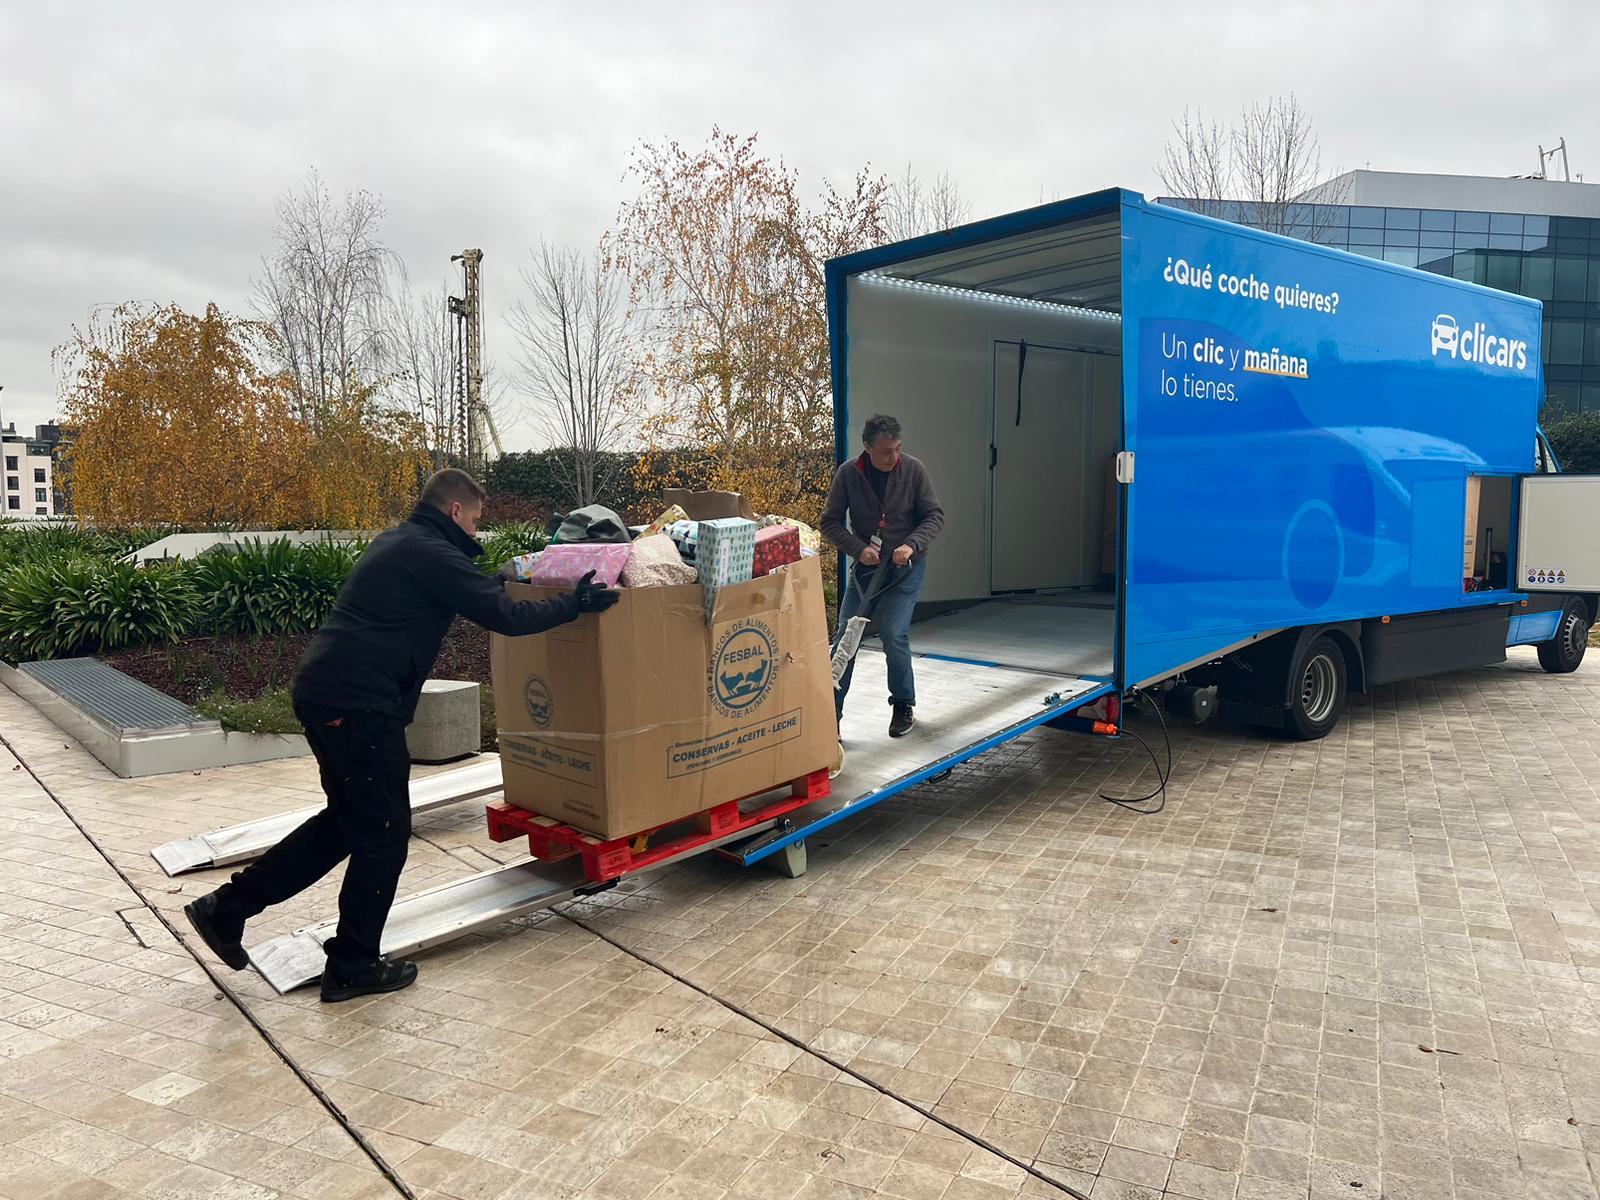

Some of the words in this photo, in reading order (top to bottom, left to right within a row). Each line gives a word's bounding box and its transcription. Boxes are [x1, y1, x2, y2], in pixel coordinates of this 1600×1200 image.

[1163, 257, 1213, 290] ¿Qué
[1218, 273, 1269, 301] coche
[1274, 283, 1339, 314] quieres?
[1162, 332, 1187, 360] Un
[1193, 337, 1224, 364] clic
[1229, 348, 1240, 371] y
[1244, 347, 1308, 375] mañana
[1460, 322, 1527, 370] clicars
[1161, 369, 1177, 396] lo
[1183, 373, 1238, 402] tienes.
[707, 630, 731, 674] BANCOS
[732, 620, 744, 632] DE
[745, 618, 779, 655] ALIMENTOS
[723, 645, 764, 665] FESBAL
[707, 685, 729, 718] BANCOS
[730, 710, 742, 719] DE
[744, 665, 779, 716] ALIMENTOS
[672, 740, 730, 763] CONSERVAS
[736, 726, 766, 746] ACEITE
[772, 716, 797, 733] LECHE
